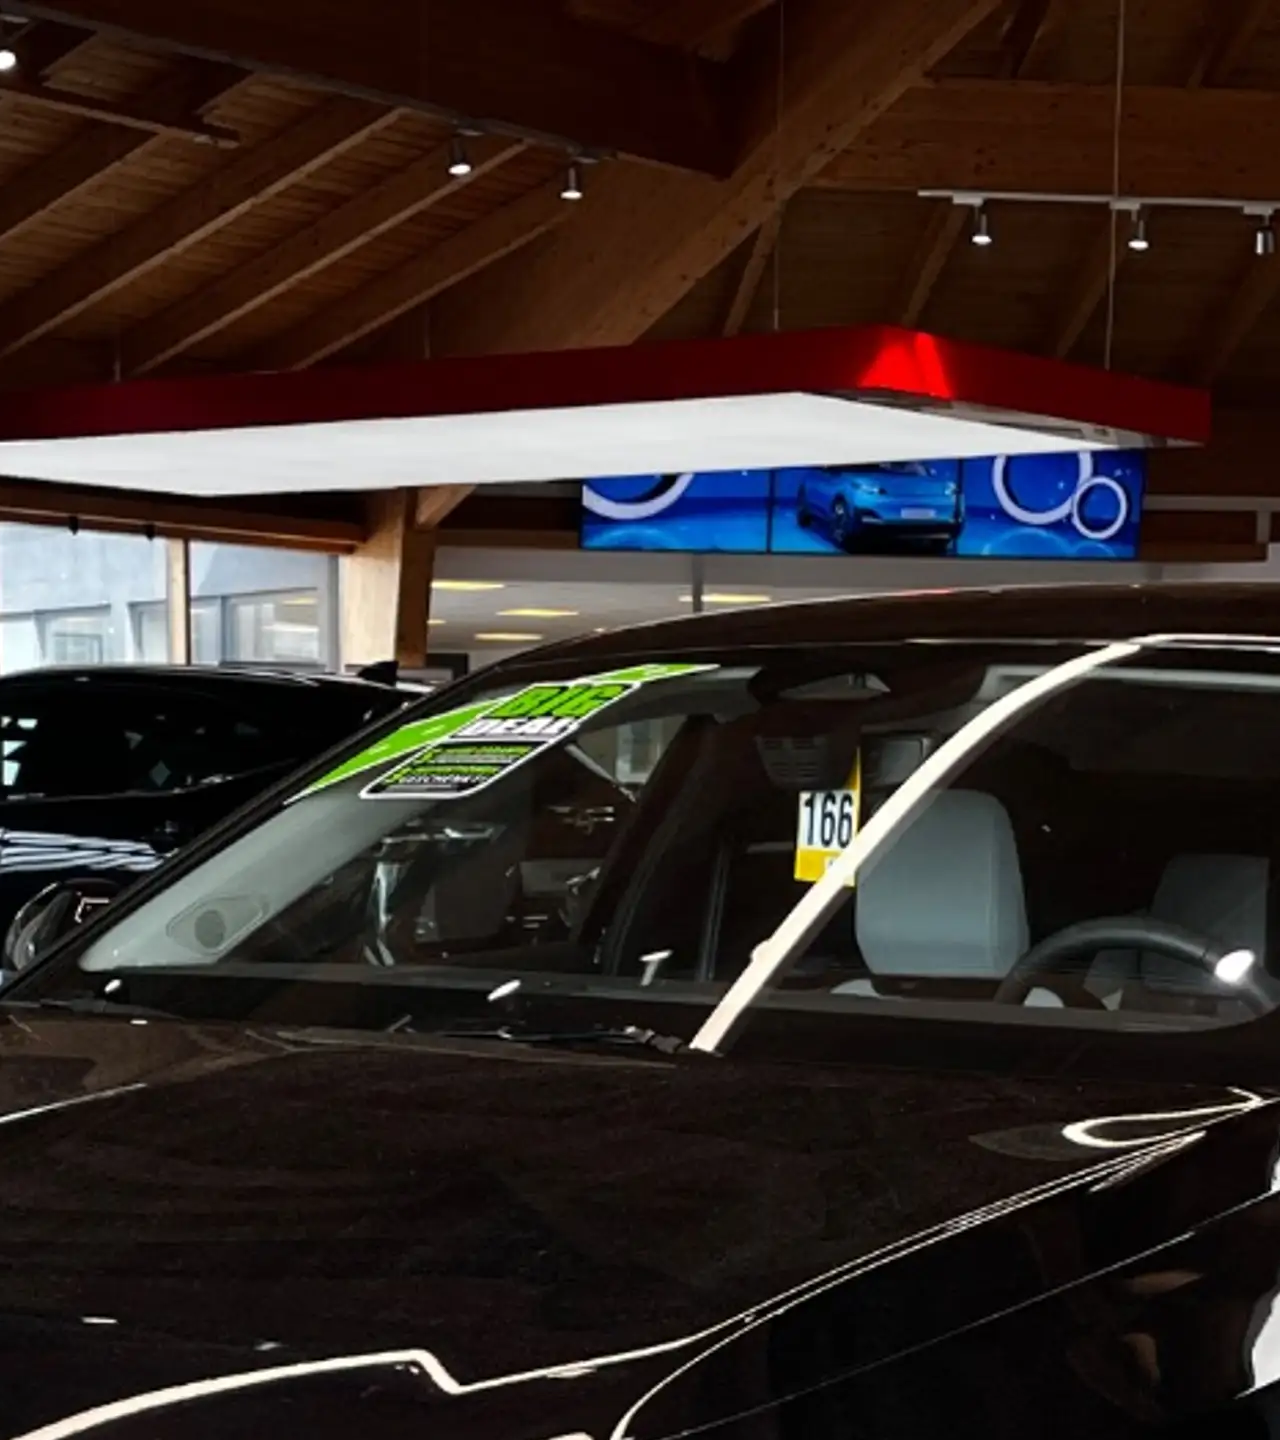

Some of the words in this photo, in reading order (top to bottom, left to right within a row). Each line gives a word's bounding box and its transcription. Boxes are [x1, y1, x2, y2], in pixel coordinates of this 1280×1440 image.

[486, 683, 625, 718] BIG
[452, 716, 578, 739] DEAL
[804, 791, 854, 849] 166
